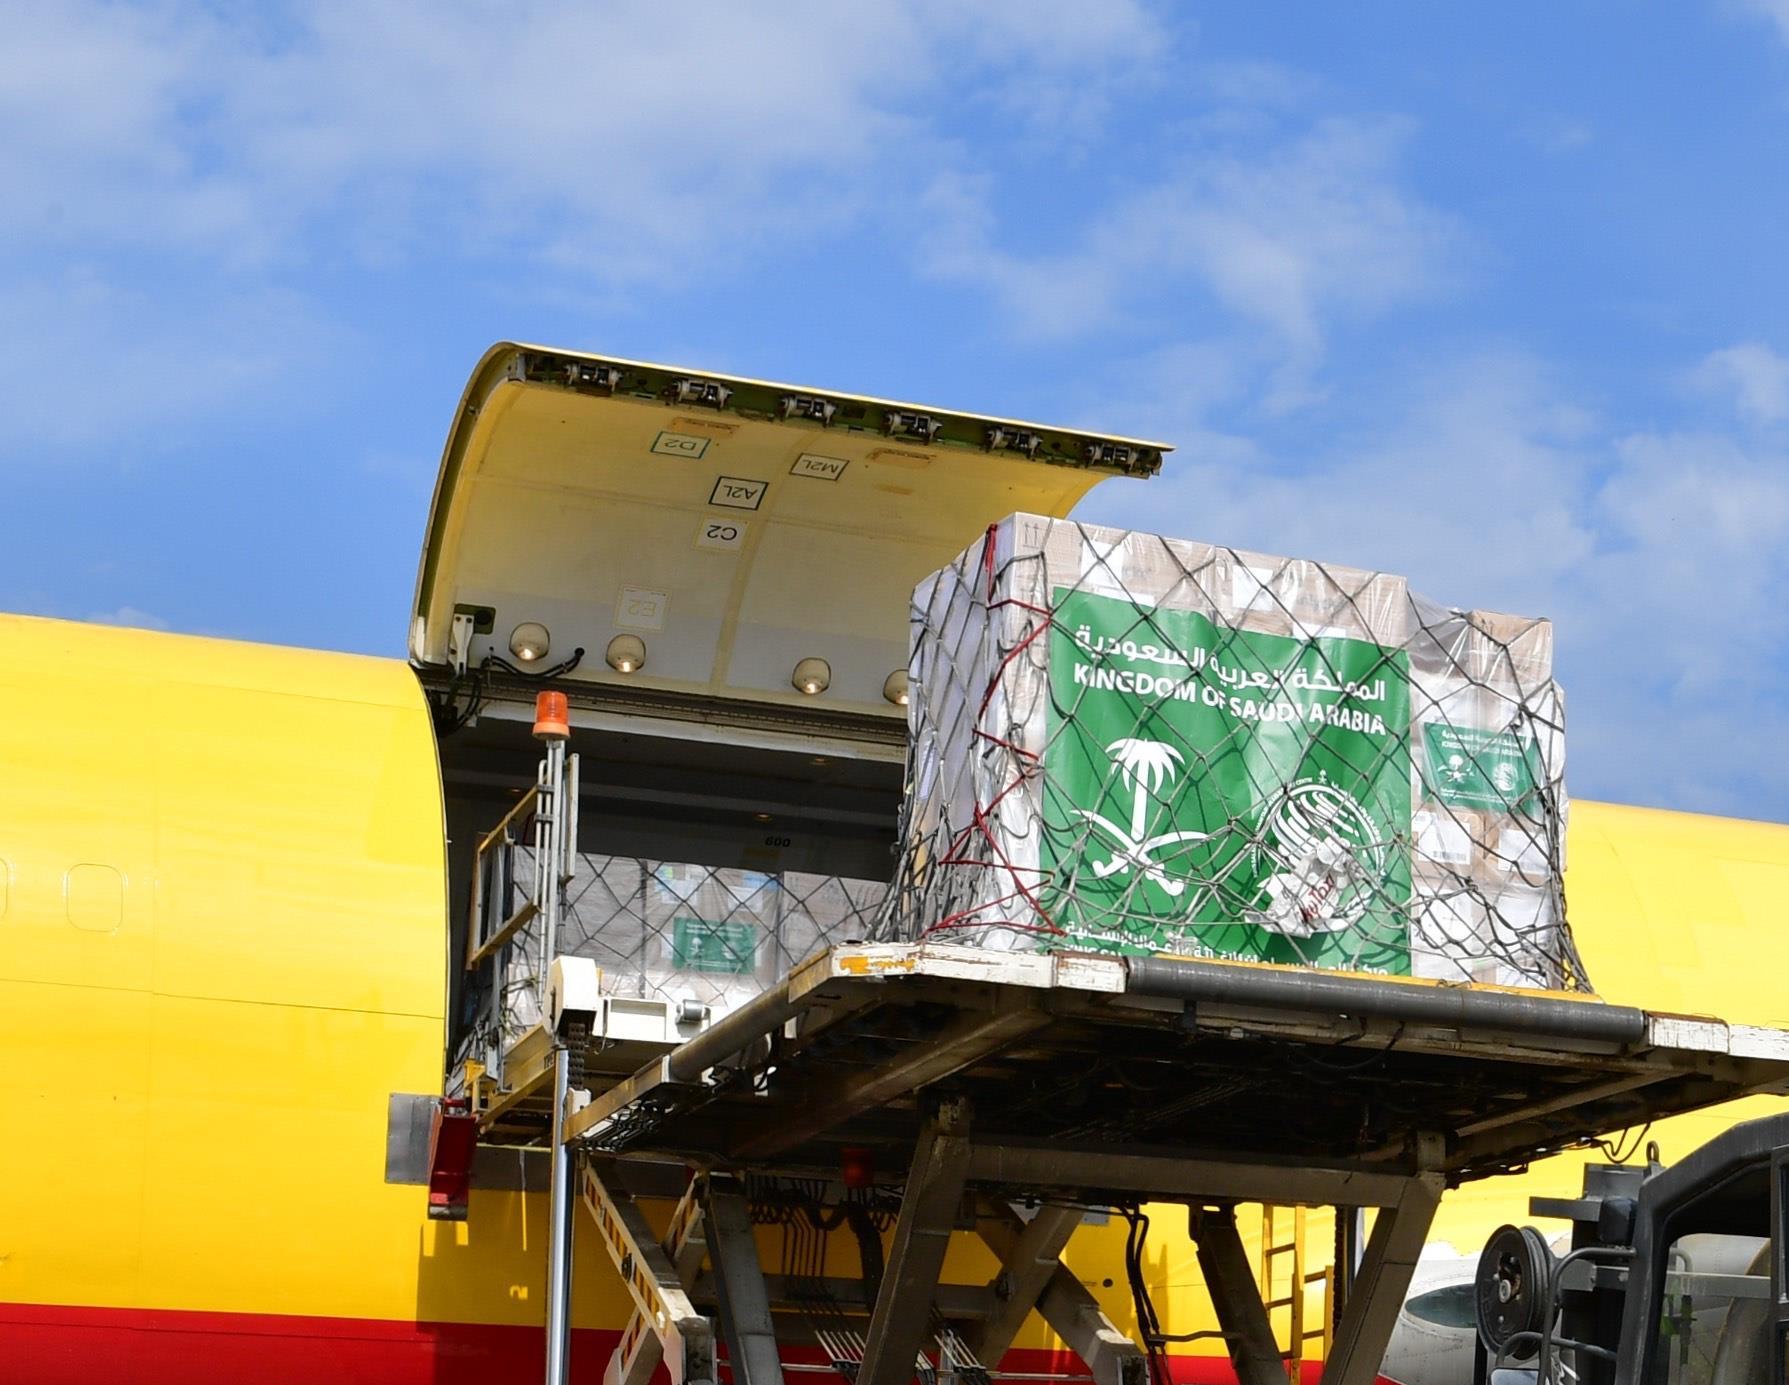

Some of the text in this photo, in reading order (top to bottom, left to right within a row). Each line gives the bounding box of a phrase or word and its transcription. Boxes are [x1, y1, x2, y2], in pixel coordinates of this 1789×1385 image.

[664, 439, 698, 451] D2
[801, 459, 840, 473] M2L
[722, 485, 758, 500] A2L
[706, 524, 738, 541] C2
[1074, 624, 1205, 669] السعودية
[1073, 662, 1387, 736] KINGDOM OF SAUDI ARABIA
[765, 836, 791, 848] 600
